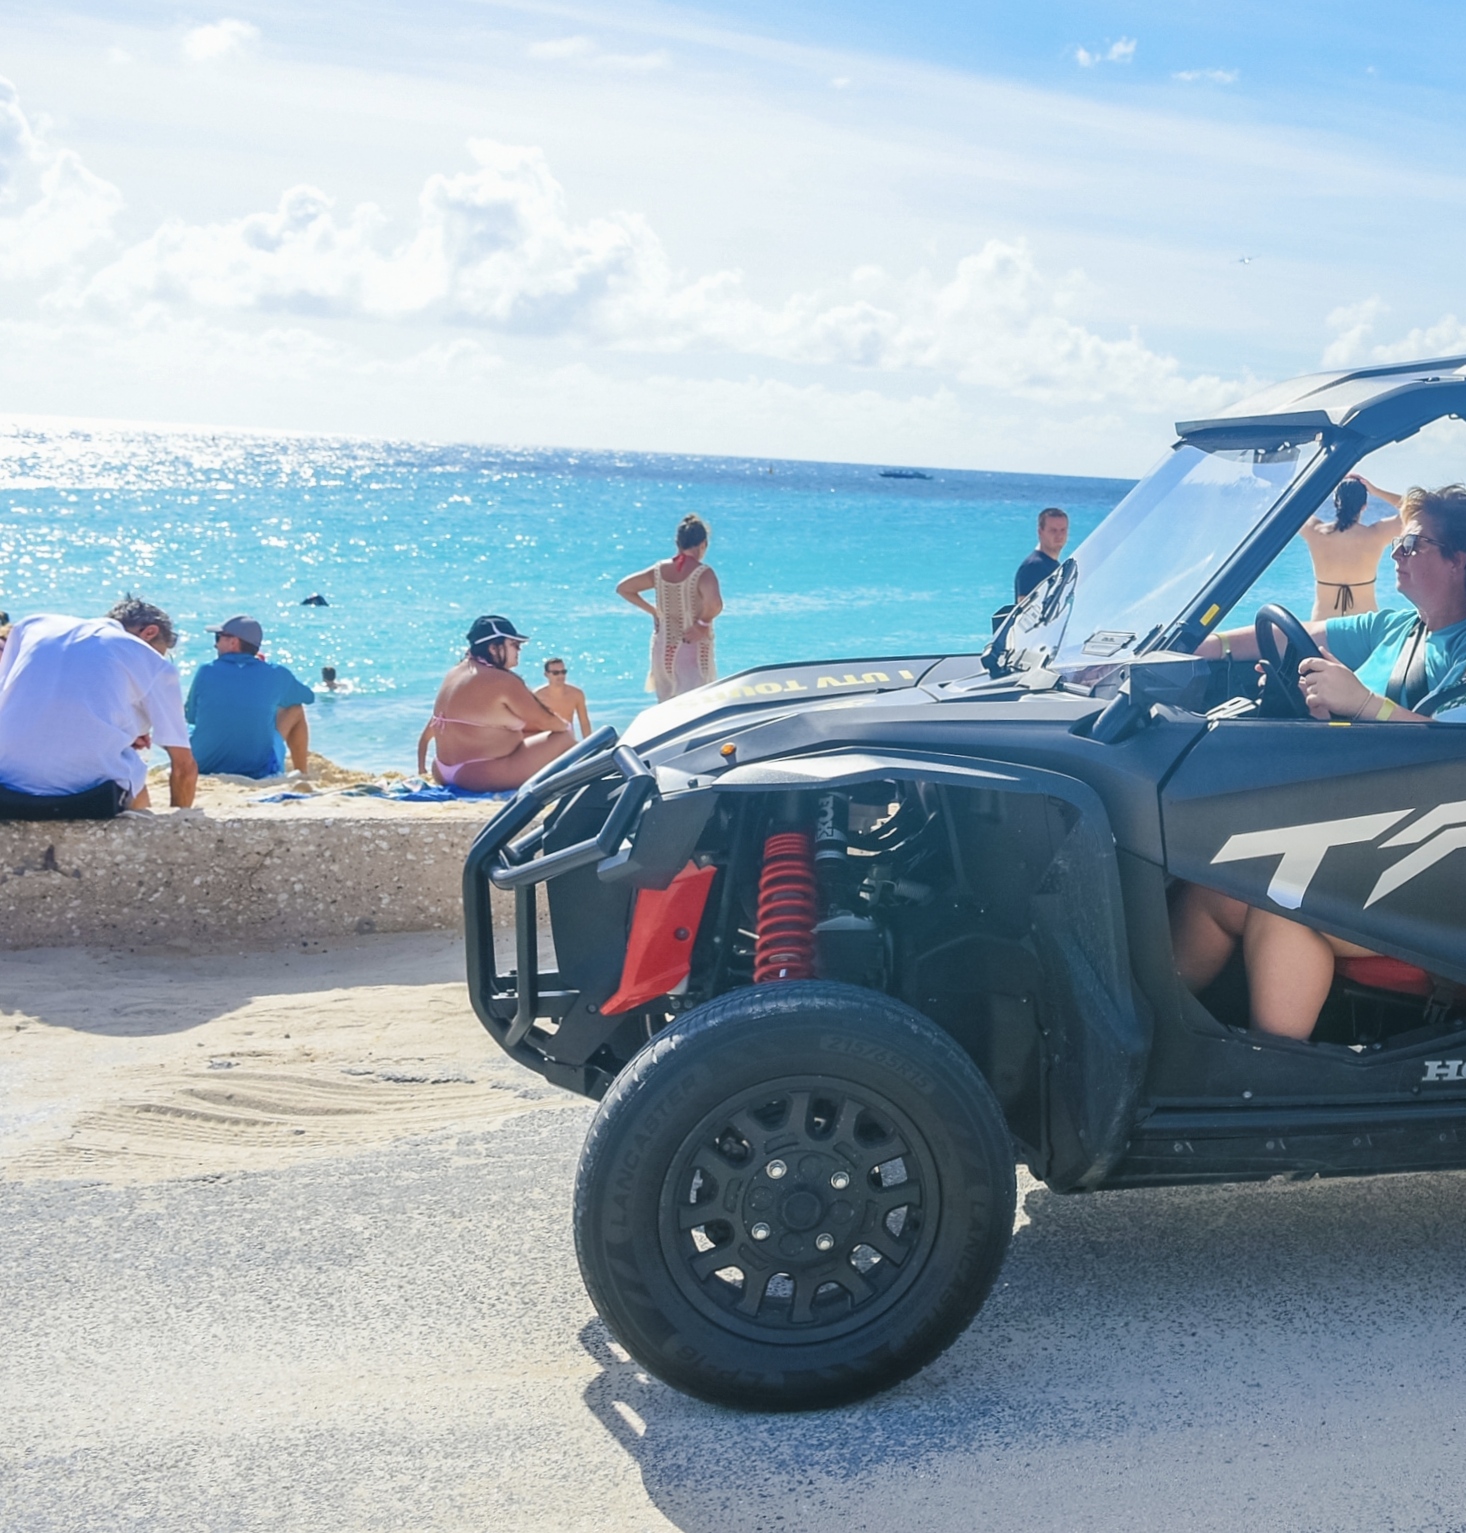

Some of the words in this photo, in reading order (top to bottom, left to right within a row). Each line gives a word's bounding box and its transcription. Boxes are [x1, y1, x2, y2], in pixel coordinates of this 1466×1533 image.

[816, 671, 890, 689] UTV
[816, 795, 835, 841] FOX
[610, 1071, 697, 1228] LANCASTER
